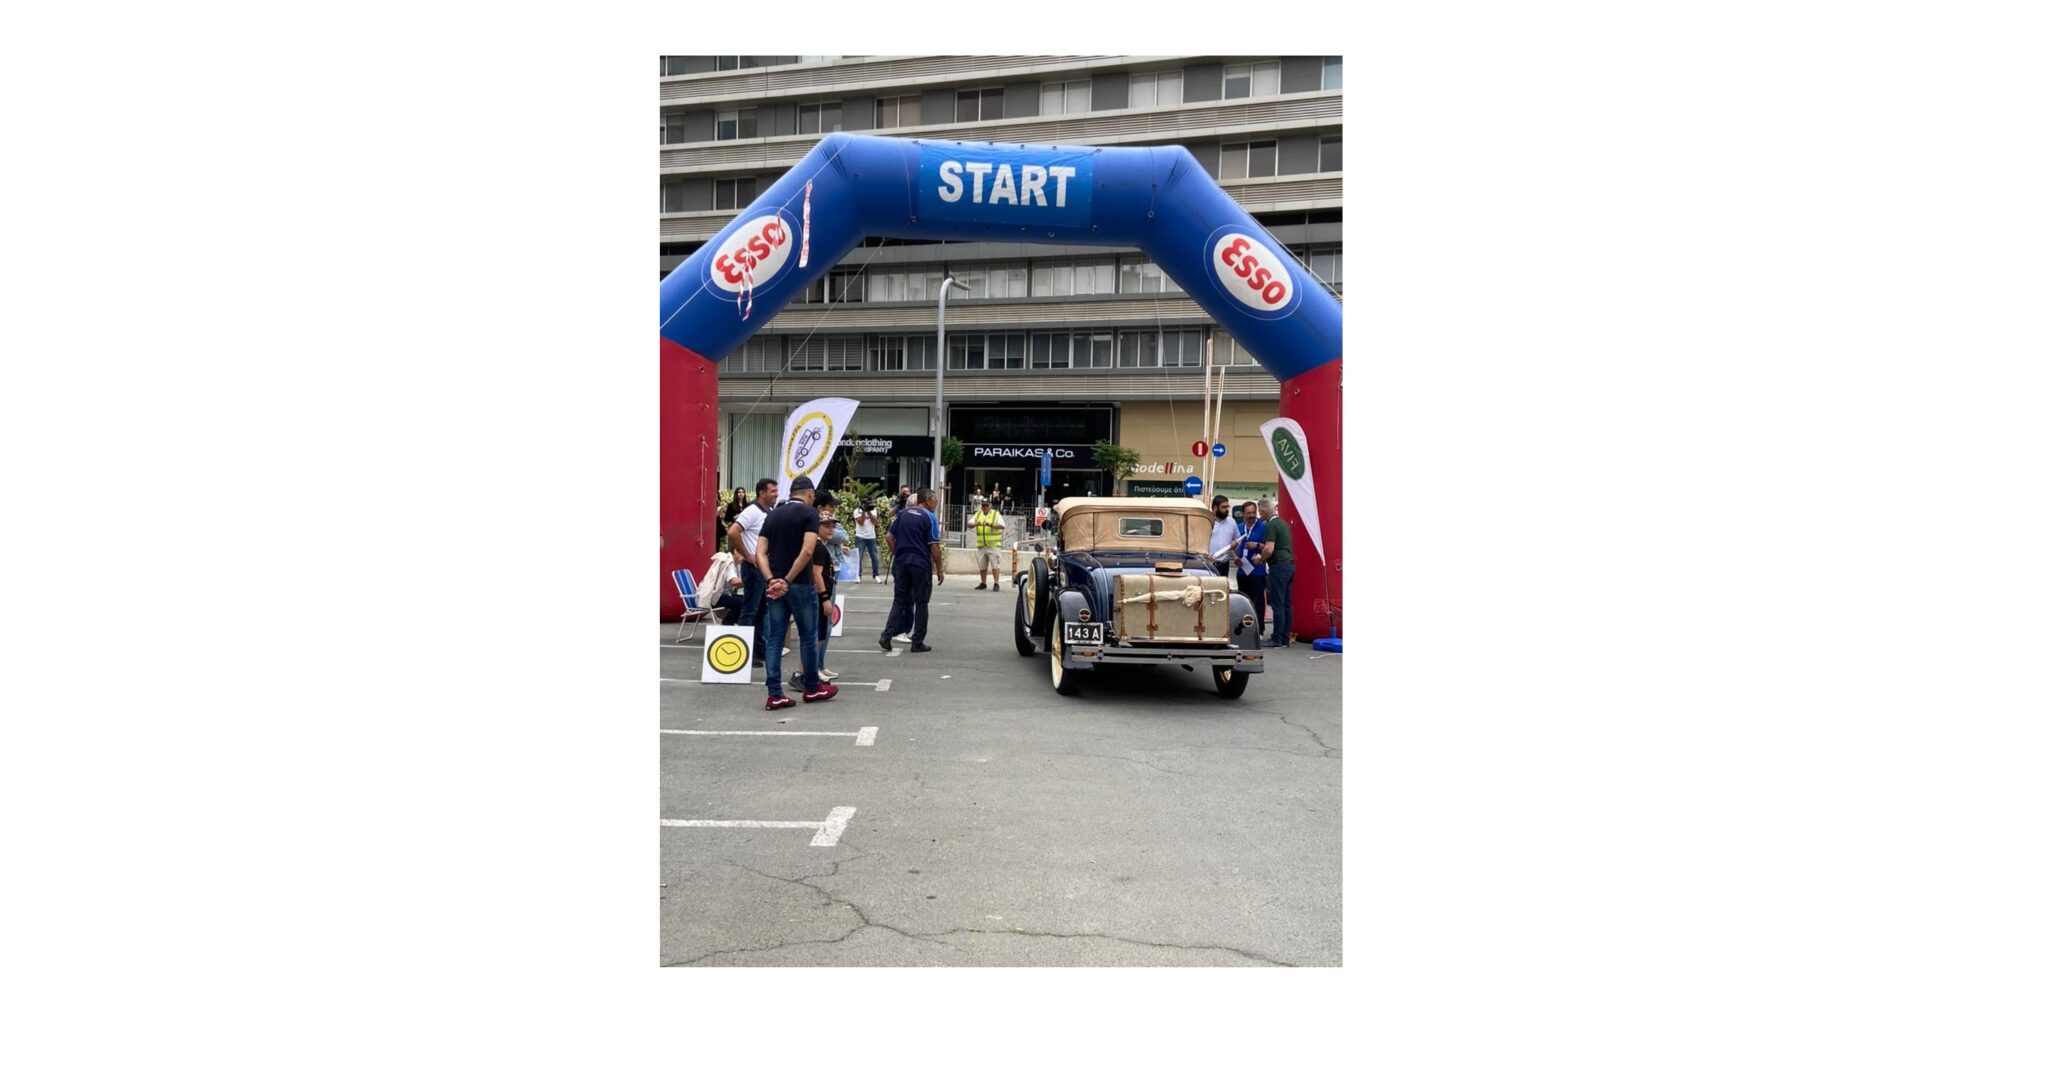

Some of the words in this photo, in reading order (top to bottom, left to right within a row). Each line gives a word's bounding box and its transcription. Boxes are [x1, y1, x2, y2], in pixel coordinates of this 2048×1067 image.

[938, 161, 1076, 208] START
[715, 223, 786, 285] Esso
[1222, 238, 1286, 305] Esso
[974, 447, 1044, 458] PARAIKAS
[1055, 449, 1075, 458] Co.
[1134, 485, 1172, 493] Πιστεύουμε
[1068, 627, 1090, 639] 143
[1091, 627, 1100, 639] A
